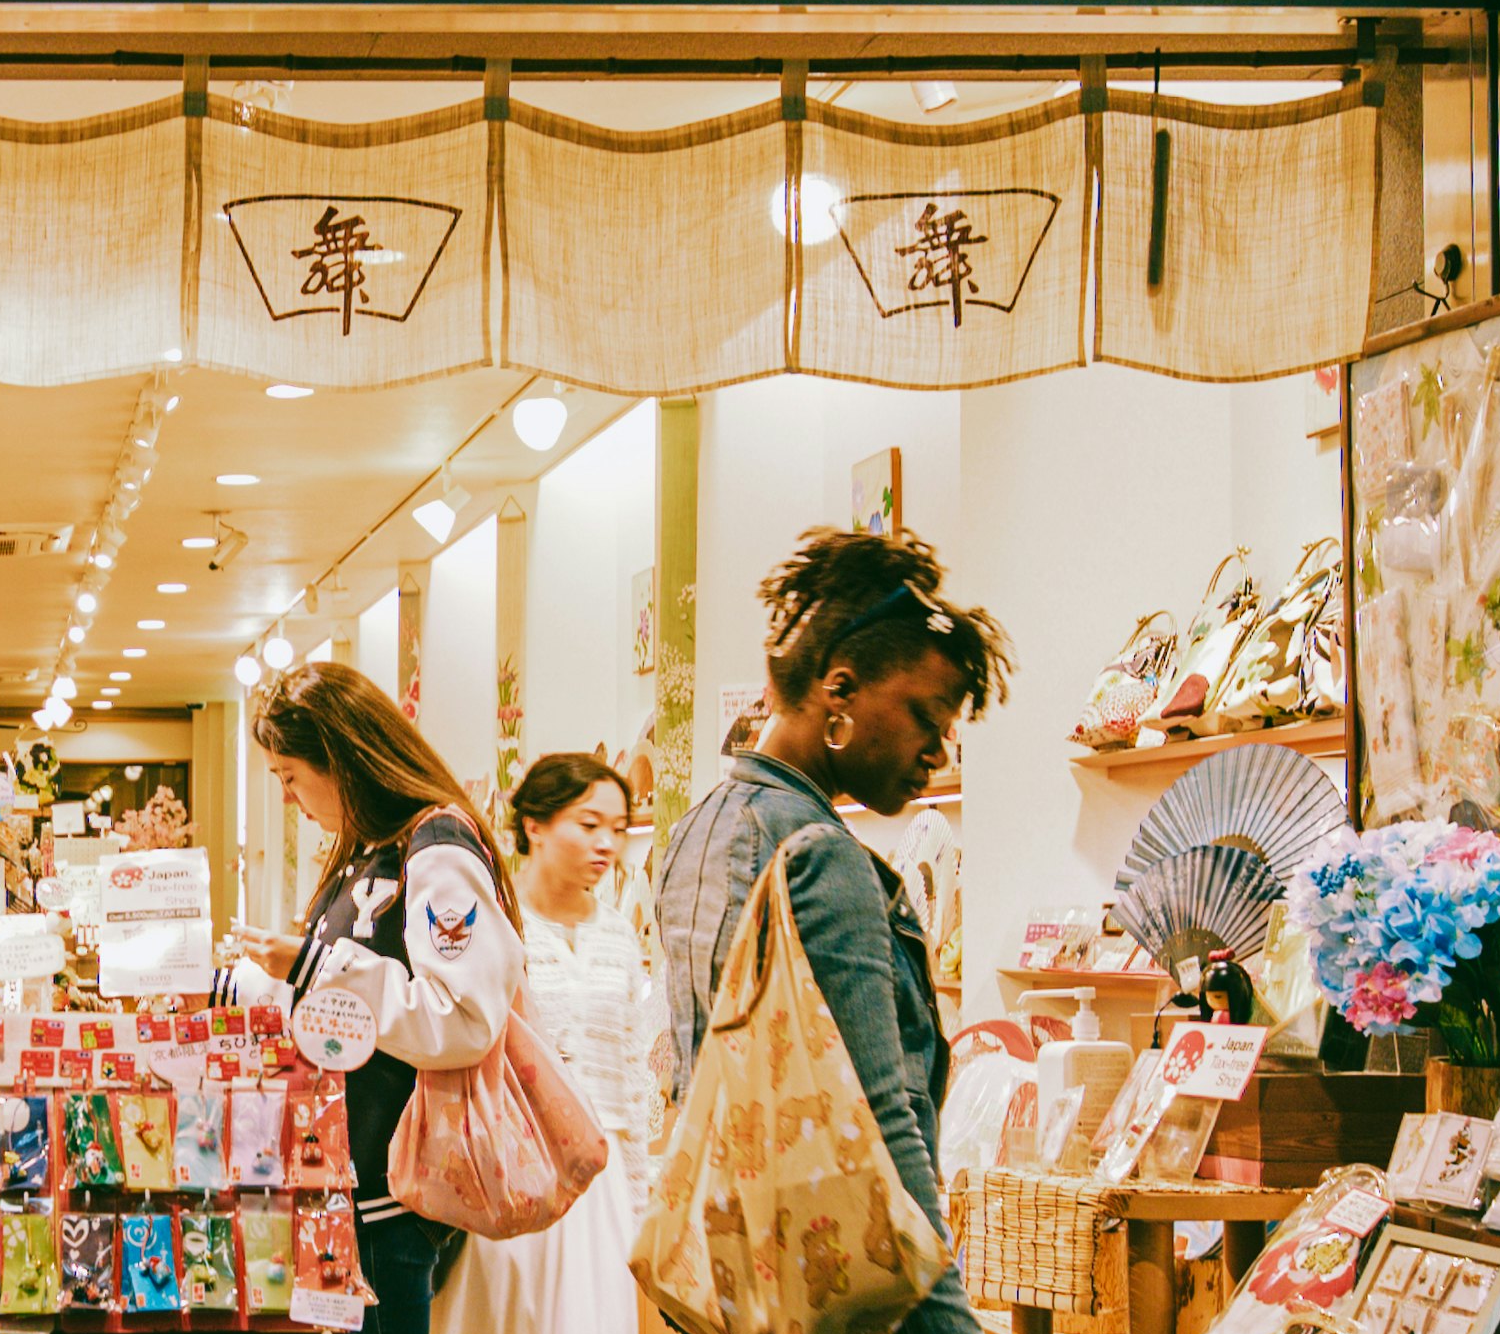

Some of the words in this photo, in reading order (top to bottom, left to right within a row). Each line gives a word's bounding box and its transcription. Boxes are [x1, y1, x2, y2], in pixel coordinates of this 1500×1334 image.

[290, 205, 383, 338] 舞
[894, 202, 988, 329] 舞
[1215, 1074, 1242, 1089] Shop
